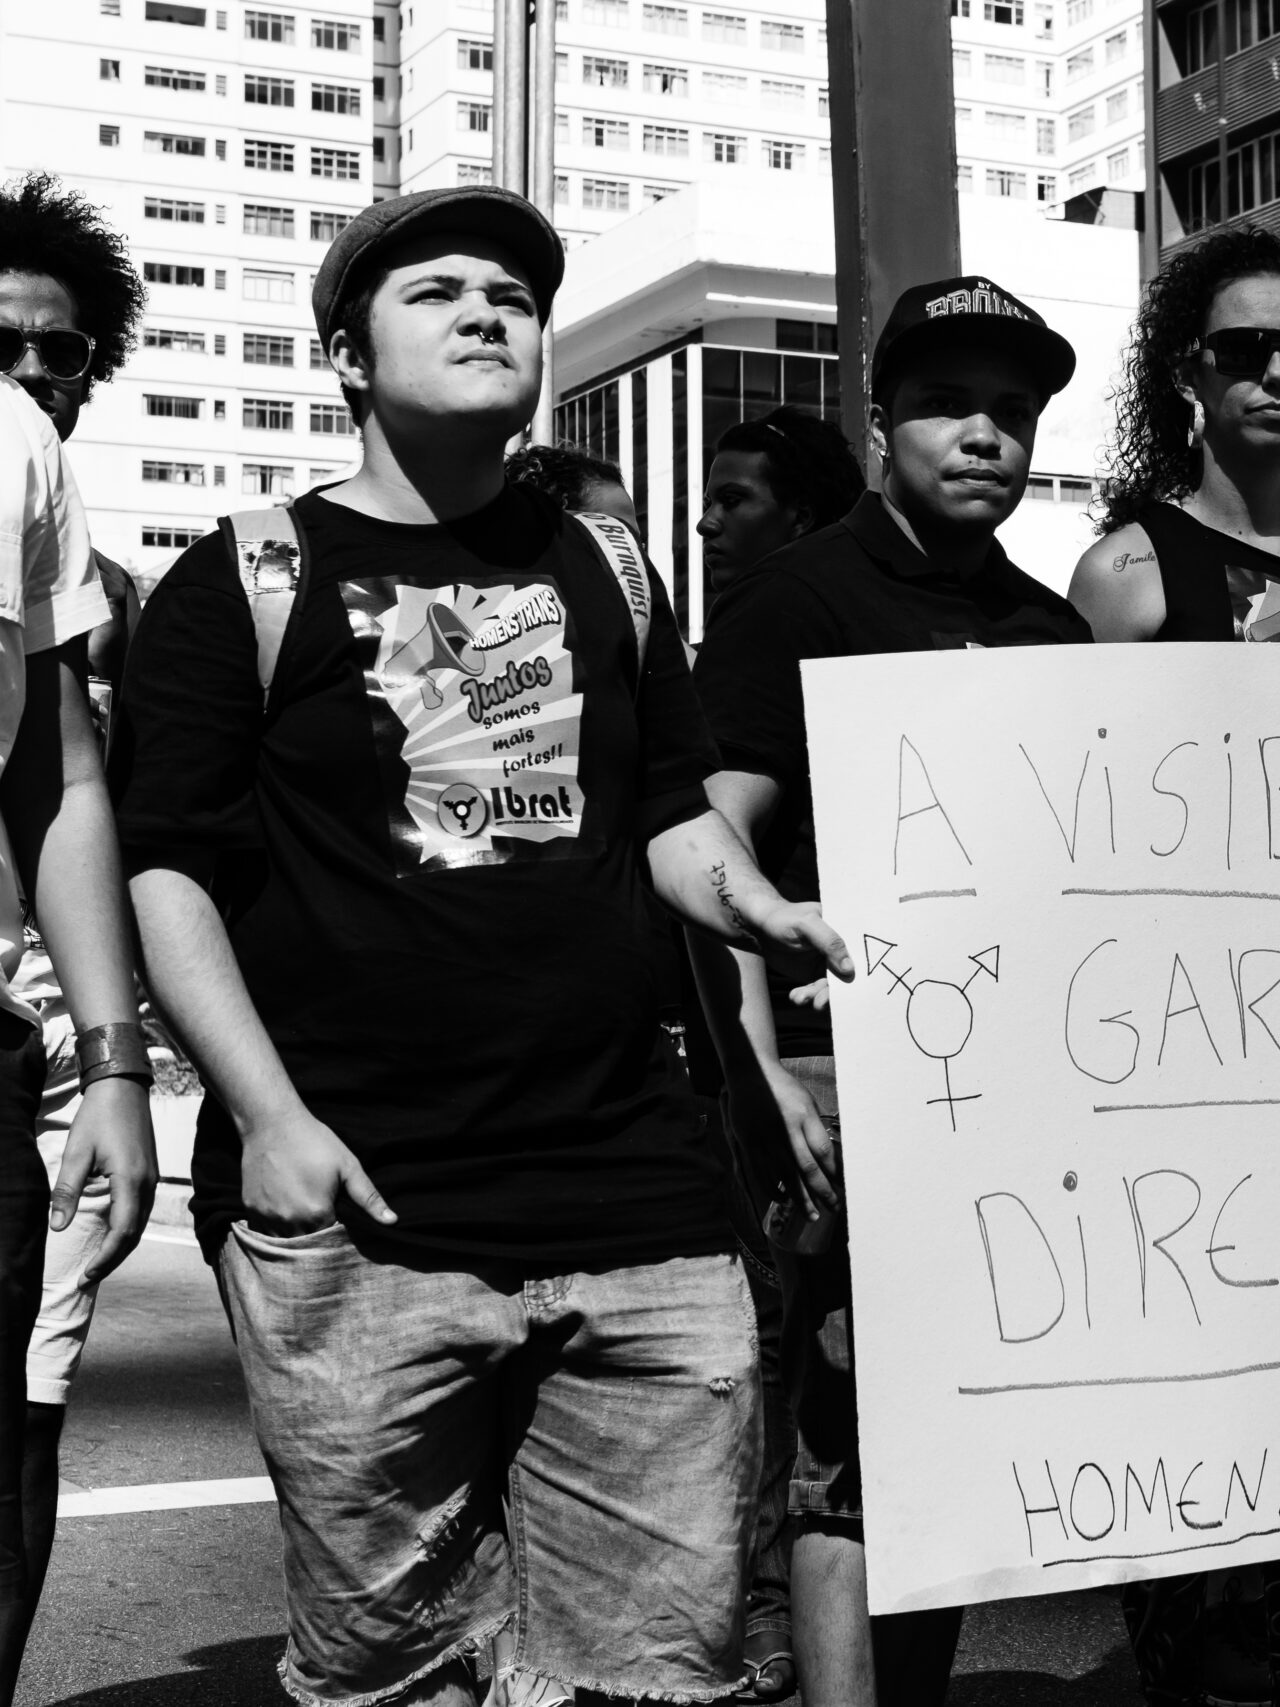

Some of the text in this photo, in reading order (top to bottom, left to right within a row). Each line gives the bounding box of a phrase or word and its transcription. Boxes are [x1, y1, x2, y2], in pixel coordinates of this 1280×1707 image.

[977, 281, 991, 290] BY
[595, 523, 650, 620] Burnquist
[468, 589, 561, 651] HOMENS TRANS
[461, 655, 553, 723] Juntos
[482, 701, 541, 730] somos
[493, 728, 535, 751] mais
[490, 786, 573, 819] Ibrat
[892, 733, 974, 876] A
